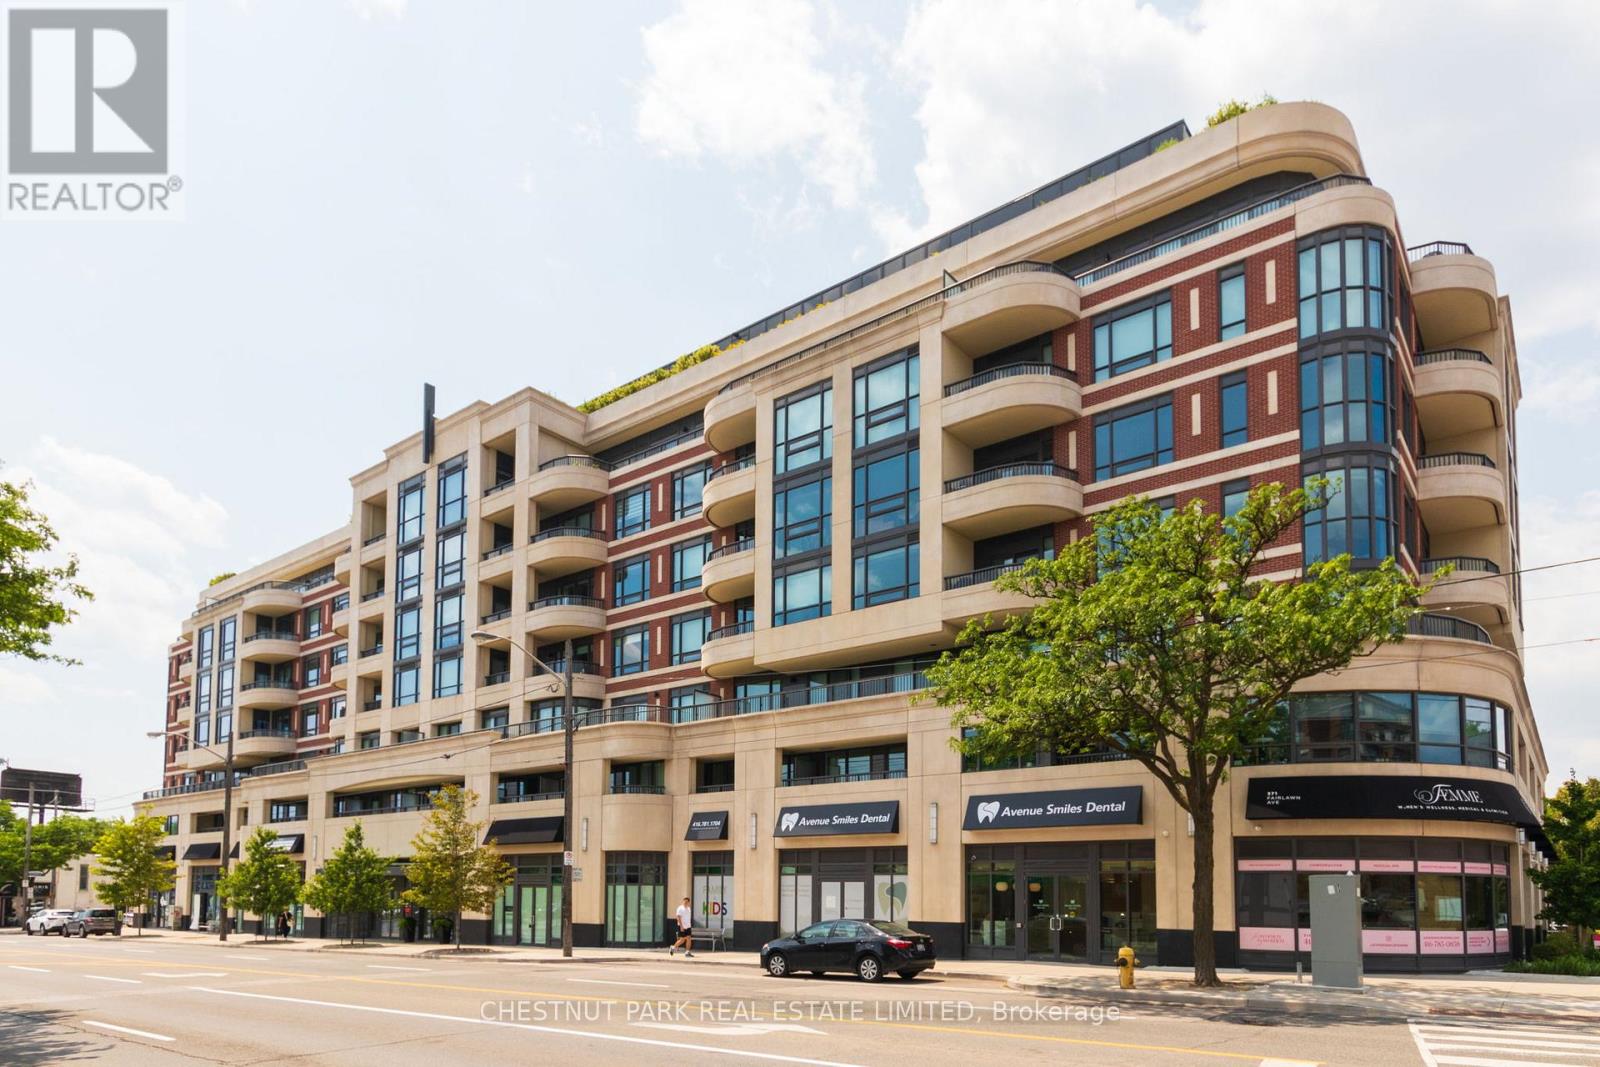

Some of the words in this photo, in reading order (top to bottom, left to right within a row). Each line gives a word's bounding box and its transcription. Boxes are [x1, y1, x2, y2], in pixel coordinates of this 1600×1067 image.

[1001, 806, 1044, 817] Avenue
[1046, 803, 1083, 815] Smiles
[1085, 801, 1127, 813] Dental
[798, 816, 831, 827] Avenue
[831, 815, 859, 825] Smiles
[860, 813, 891, 823] Dental
